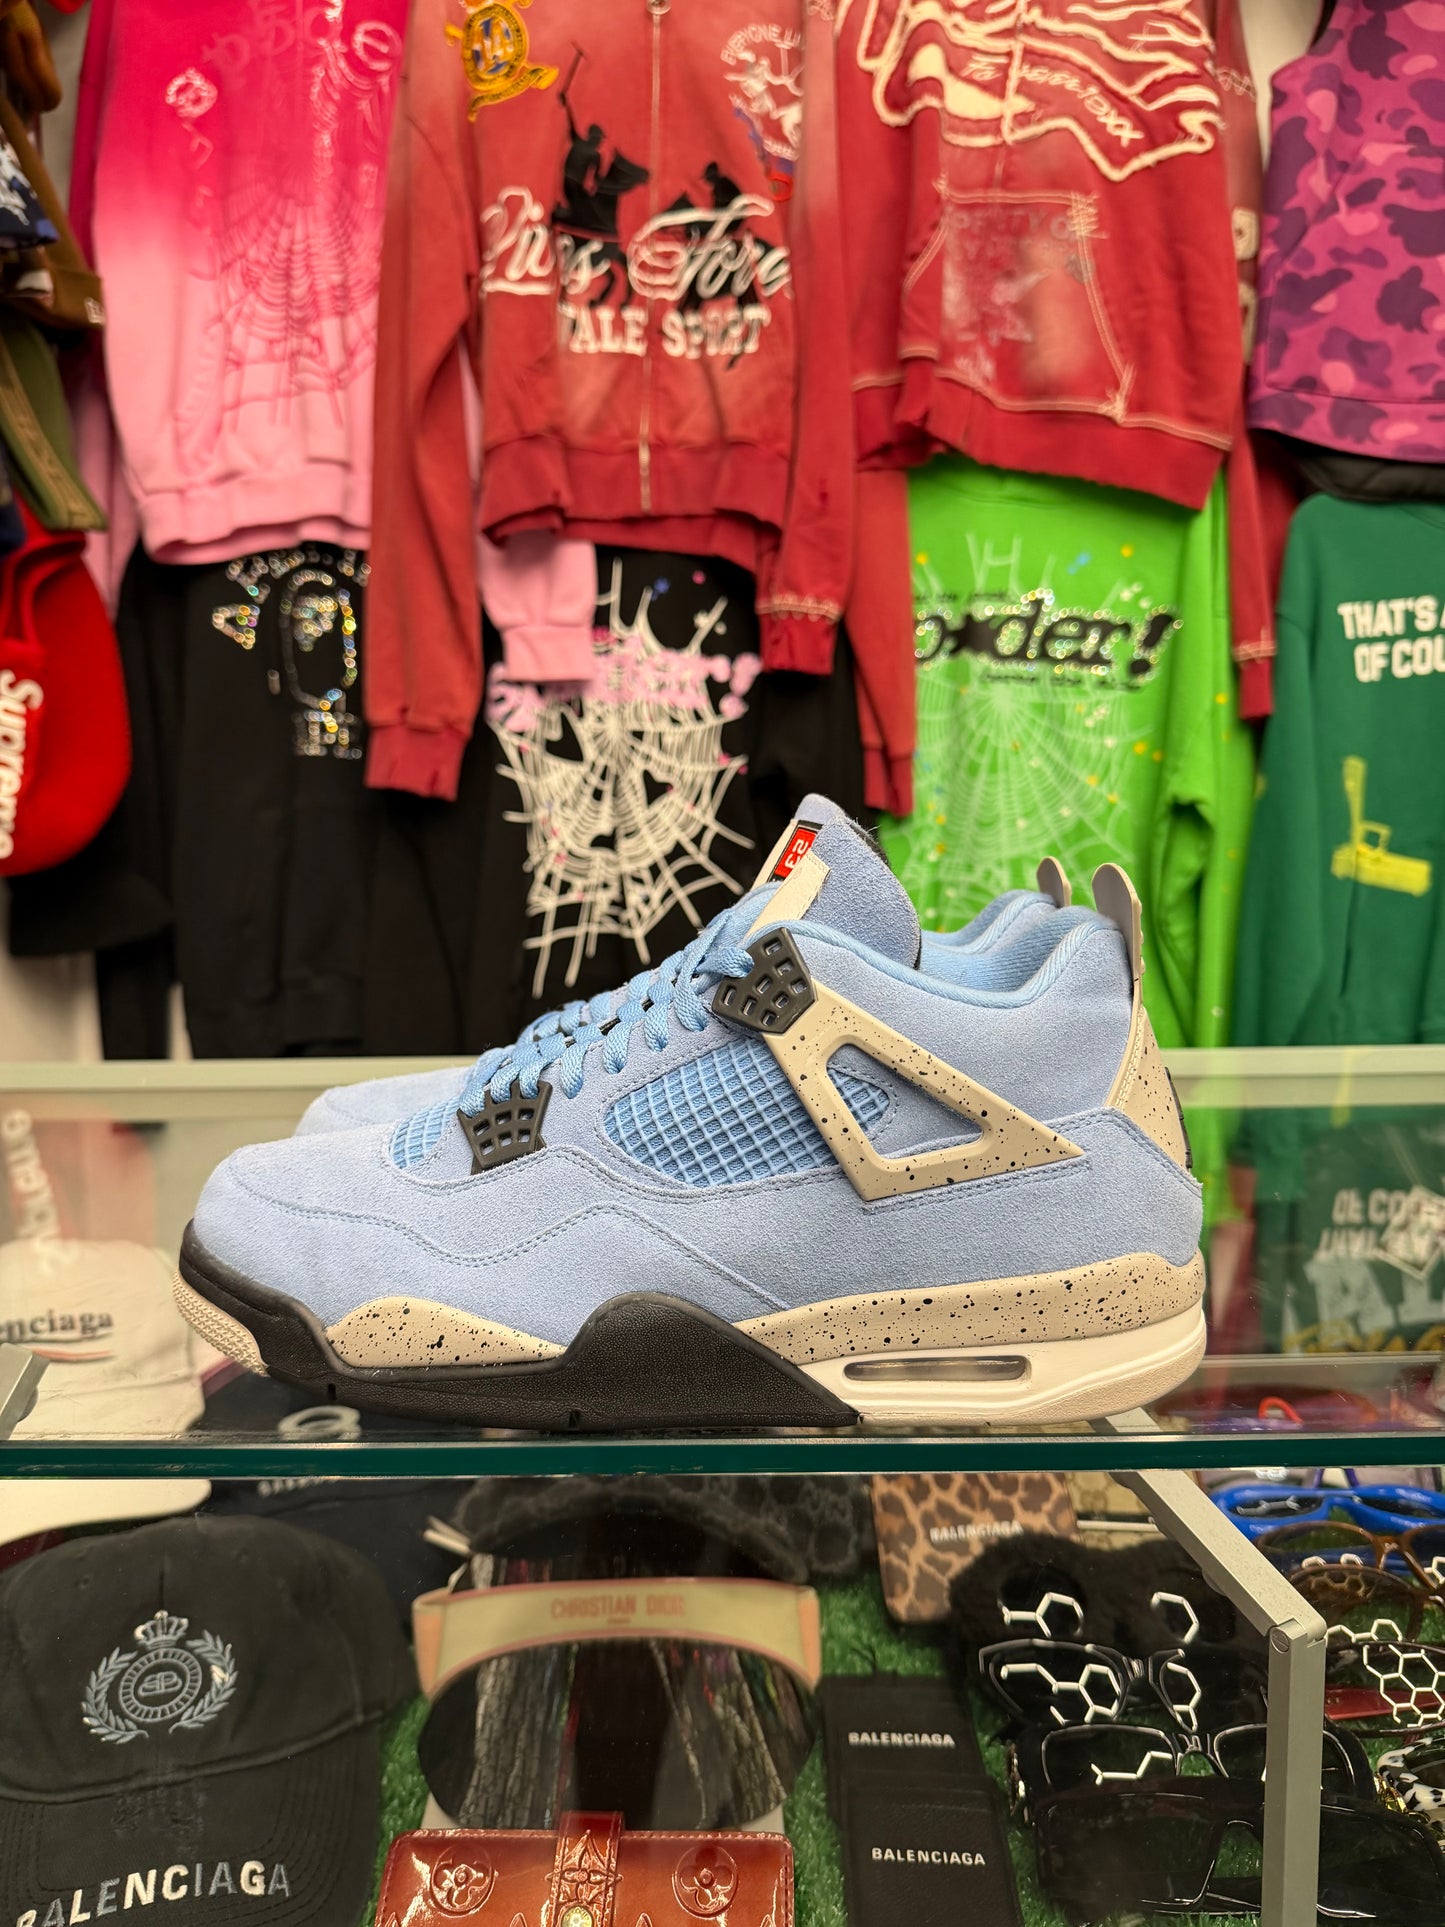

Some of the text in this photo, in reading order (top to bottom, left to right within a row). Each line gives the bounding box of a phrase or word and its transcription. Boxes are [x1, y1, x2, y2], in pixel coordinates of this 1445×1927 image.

[1337, 595, 1438, 640] THAT'S
[1353, 642, 1390, 683] OF
[784, 838, 809, 869] 23
[929, 1520, 1024, 1544] BALENCIAGA
[552, 1594, 637, 1621] CHRISTIAN
[848, 1731, 957, 1749] BALENCIAGA
[871, 1847, 986, 1867] BALENCIAGA
